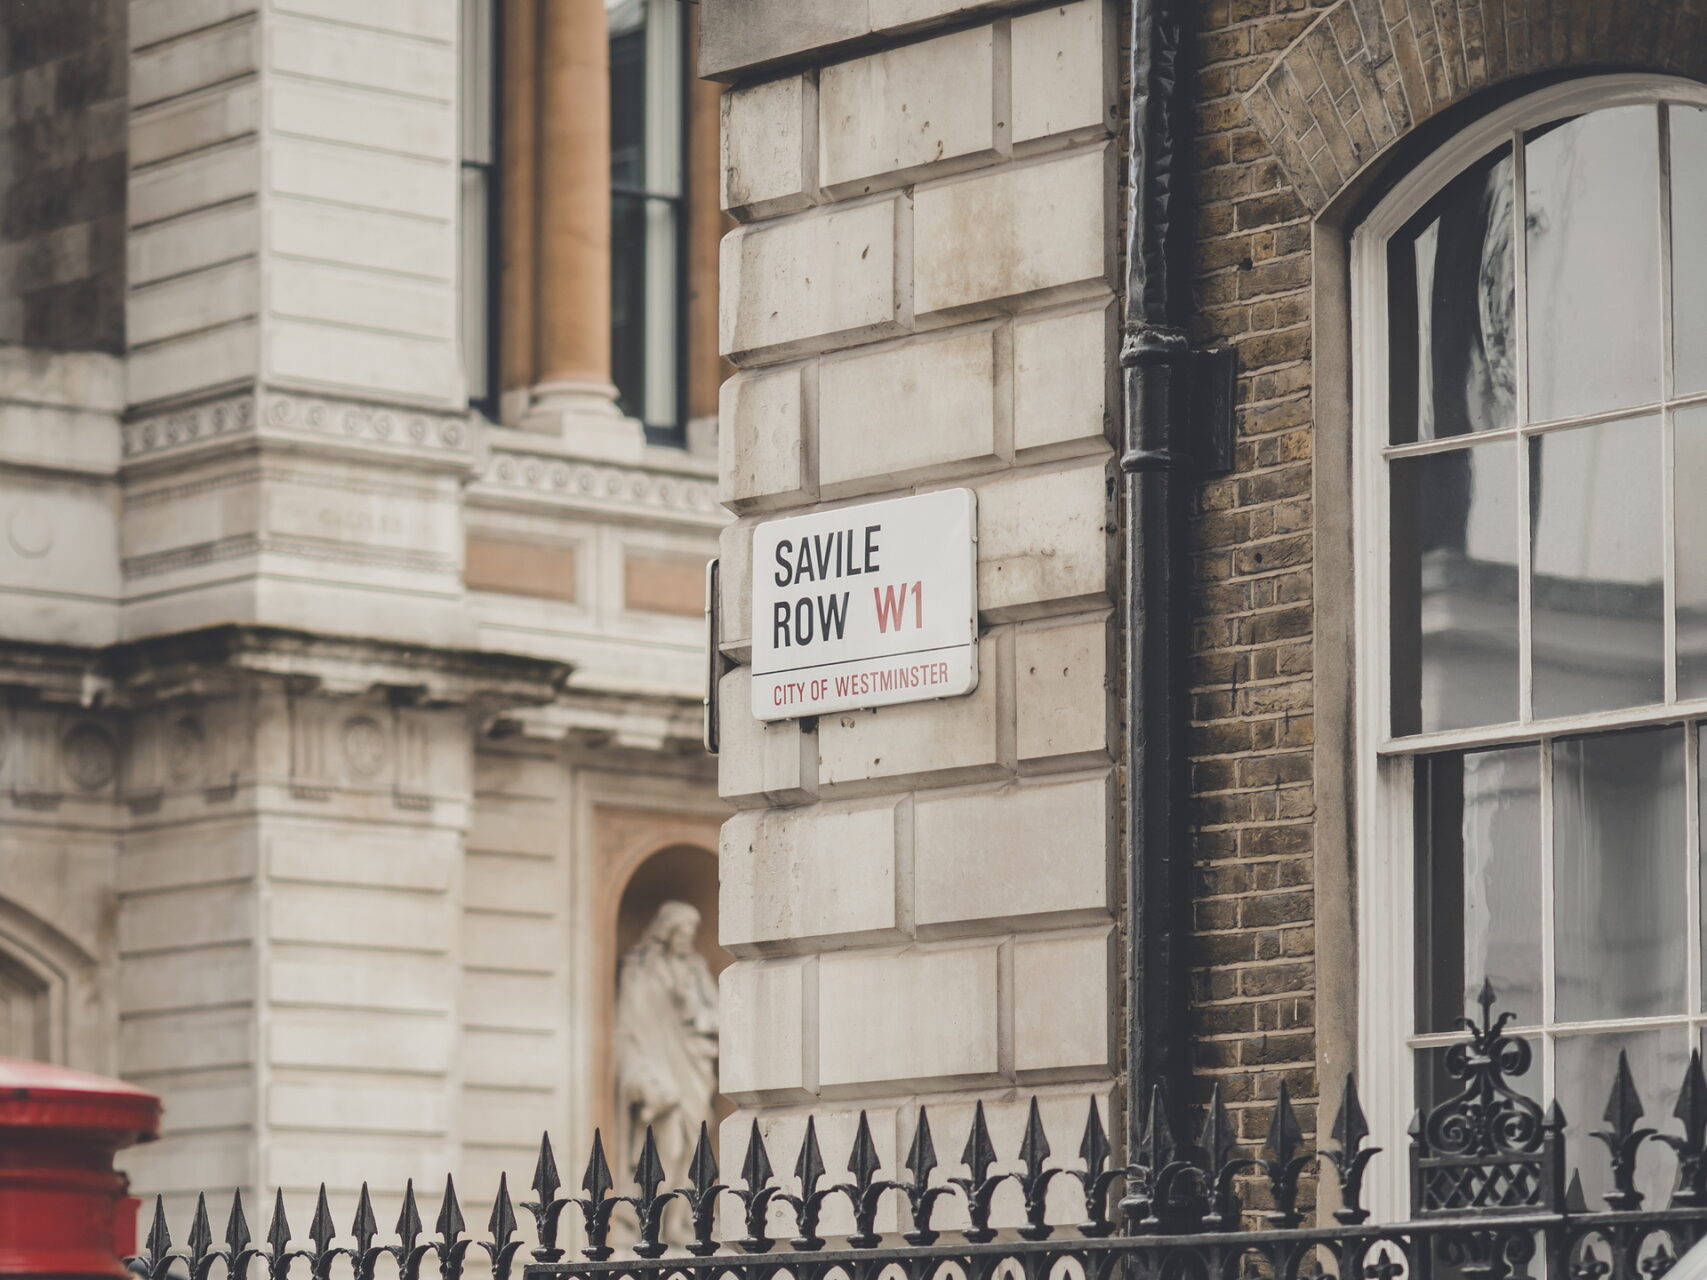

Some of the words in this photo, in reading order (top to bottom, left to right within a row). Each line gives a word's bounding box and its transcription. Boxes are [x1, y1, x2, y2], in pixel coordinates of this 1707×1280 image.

[774, 525, 881, 587] SAVILE
[773, 592, 850, 649] ROW
[873, 580, 923, 634] W1
[773, 682, 805, 706] CITY
[810, 679, 828, 701] OF
[835, 662, 948, 697] WESTMINSTER
